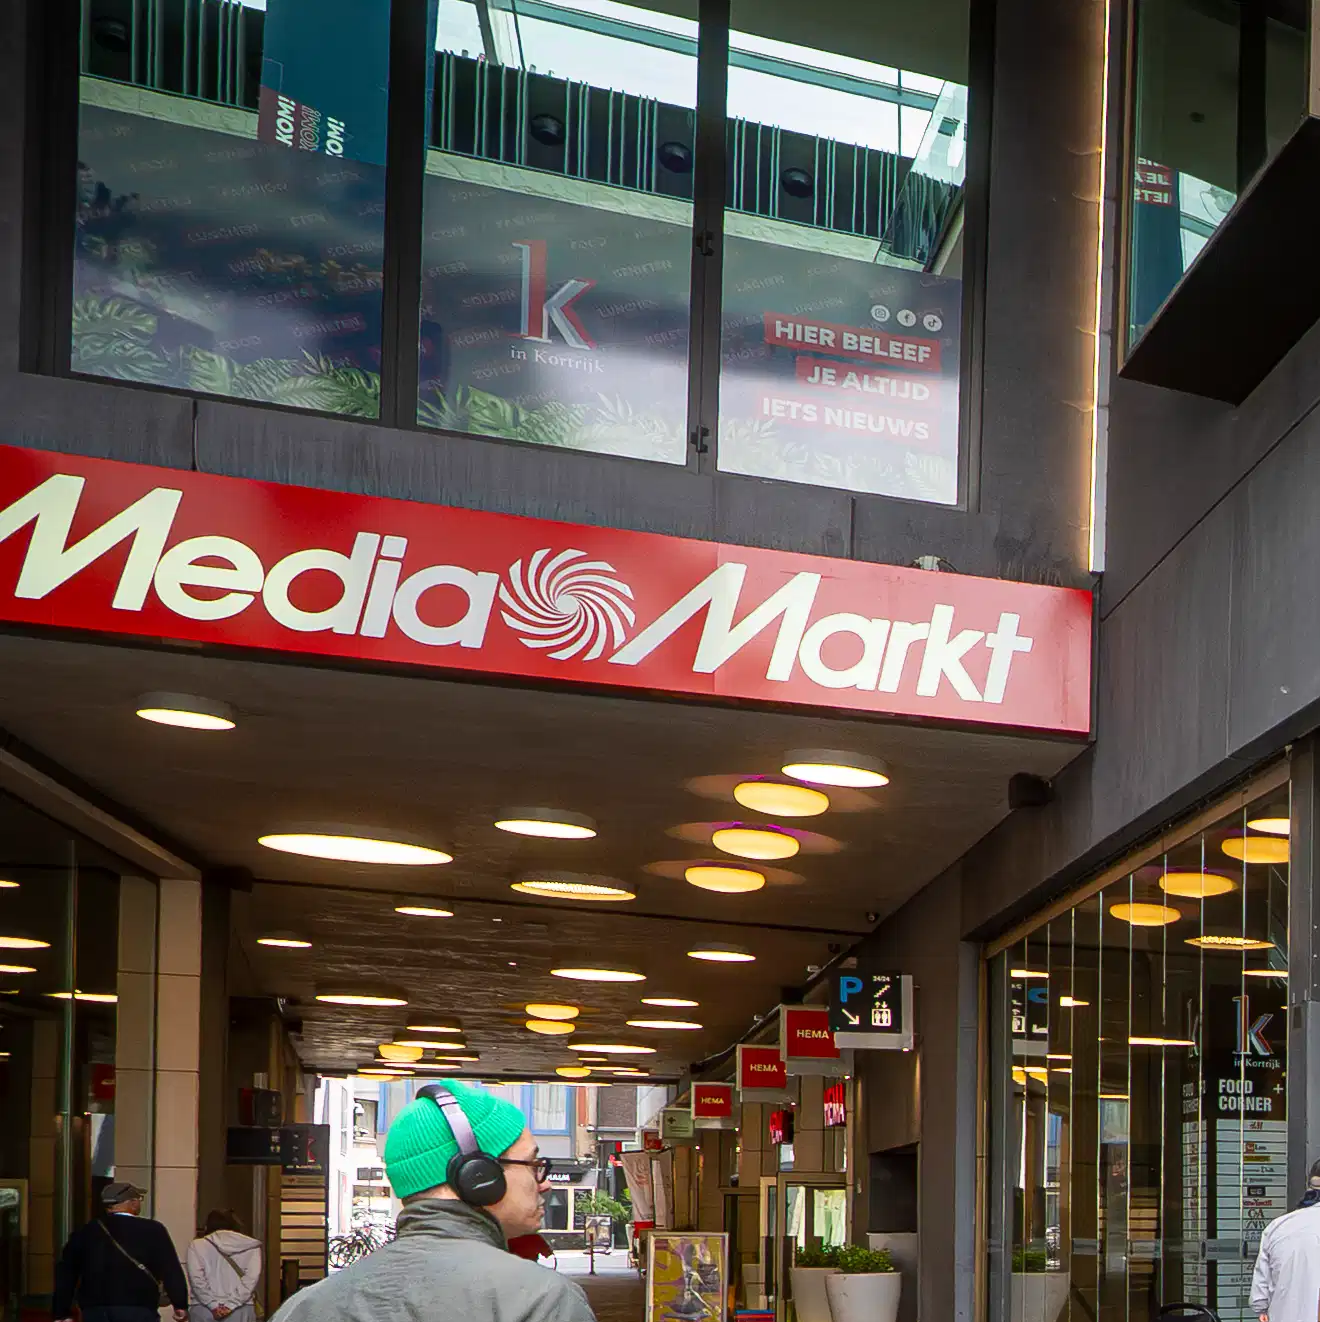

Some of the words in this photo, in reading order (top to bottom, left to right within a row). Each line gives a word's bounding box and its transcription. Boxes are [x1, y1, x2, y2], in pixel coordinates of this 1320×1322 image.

[276, 95, 296, 147] KOM!
[326, 117, 345, 157] OM!
[775, 320, 835, 348] HIER
[842, 332, 931, 363] BELEEF
[510, 345, 528, 361] in
[534, 348, 606, 374] Kortrijk
[807, 366, 836, 387] JE
[842, 372, 930, 401] ALTIJD
[762, 398, 818, 422] IETS
[824, 406, 929, 440] NIEUWS
[0, 473, 499, 649] Media
[608, 562, 1034, 704] Markt
[840, 977, 863, 1003] P
[796, 1029, 829, 1039] HEMA
[750, 1063, 778, 1073] HEMA
[1245, 1059, 1281, 1070] Kortrijk
[701, 1096, 724, 1104] HEMA
[1218, 1079, 1253, 1094] FOOD
[1218, 1096, 1272, 1112] CORNER
